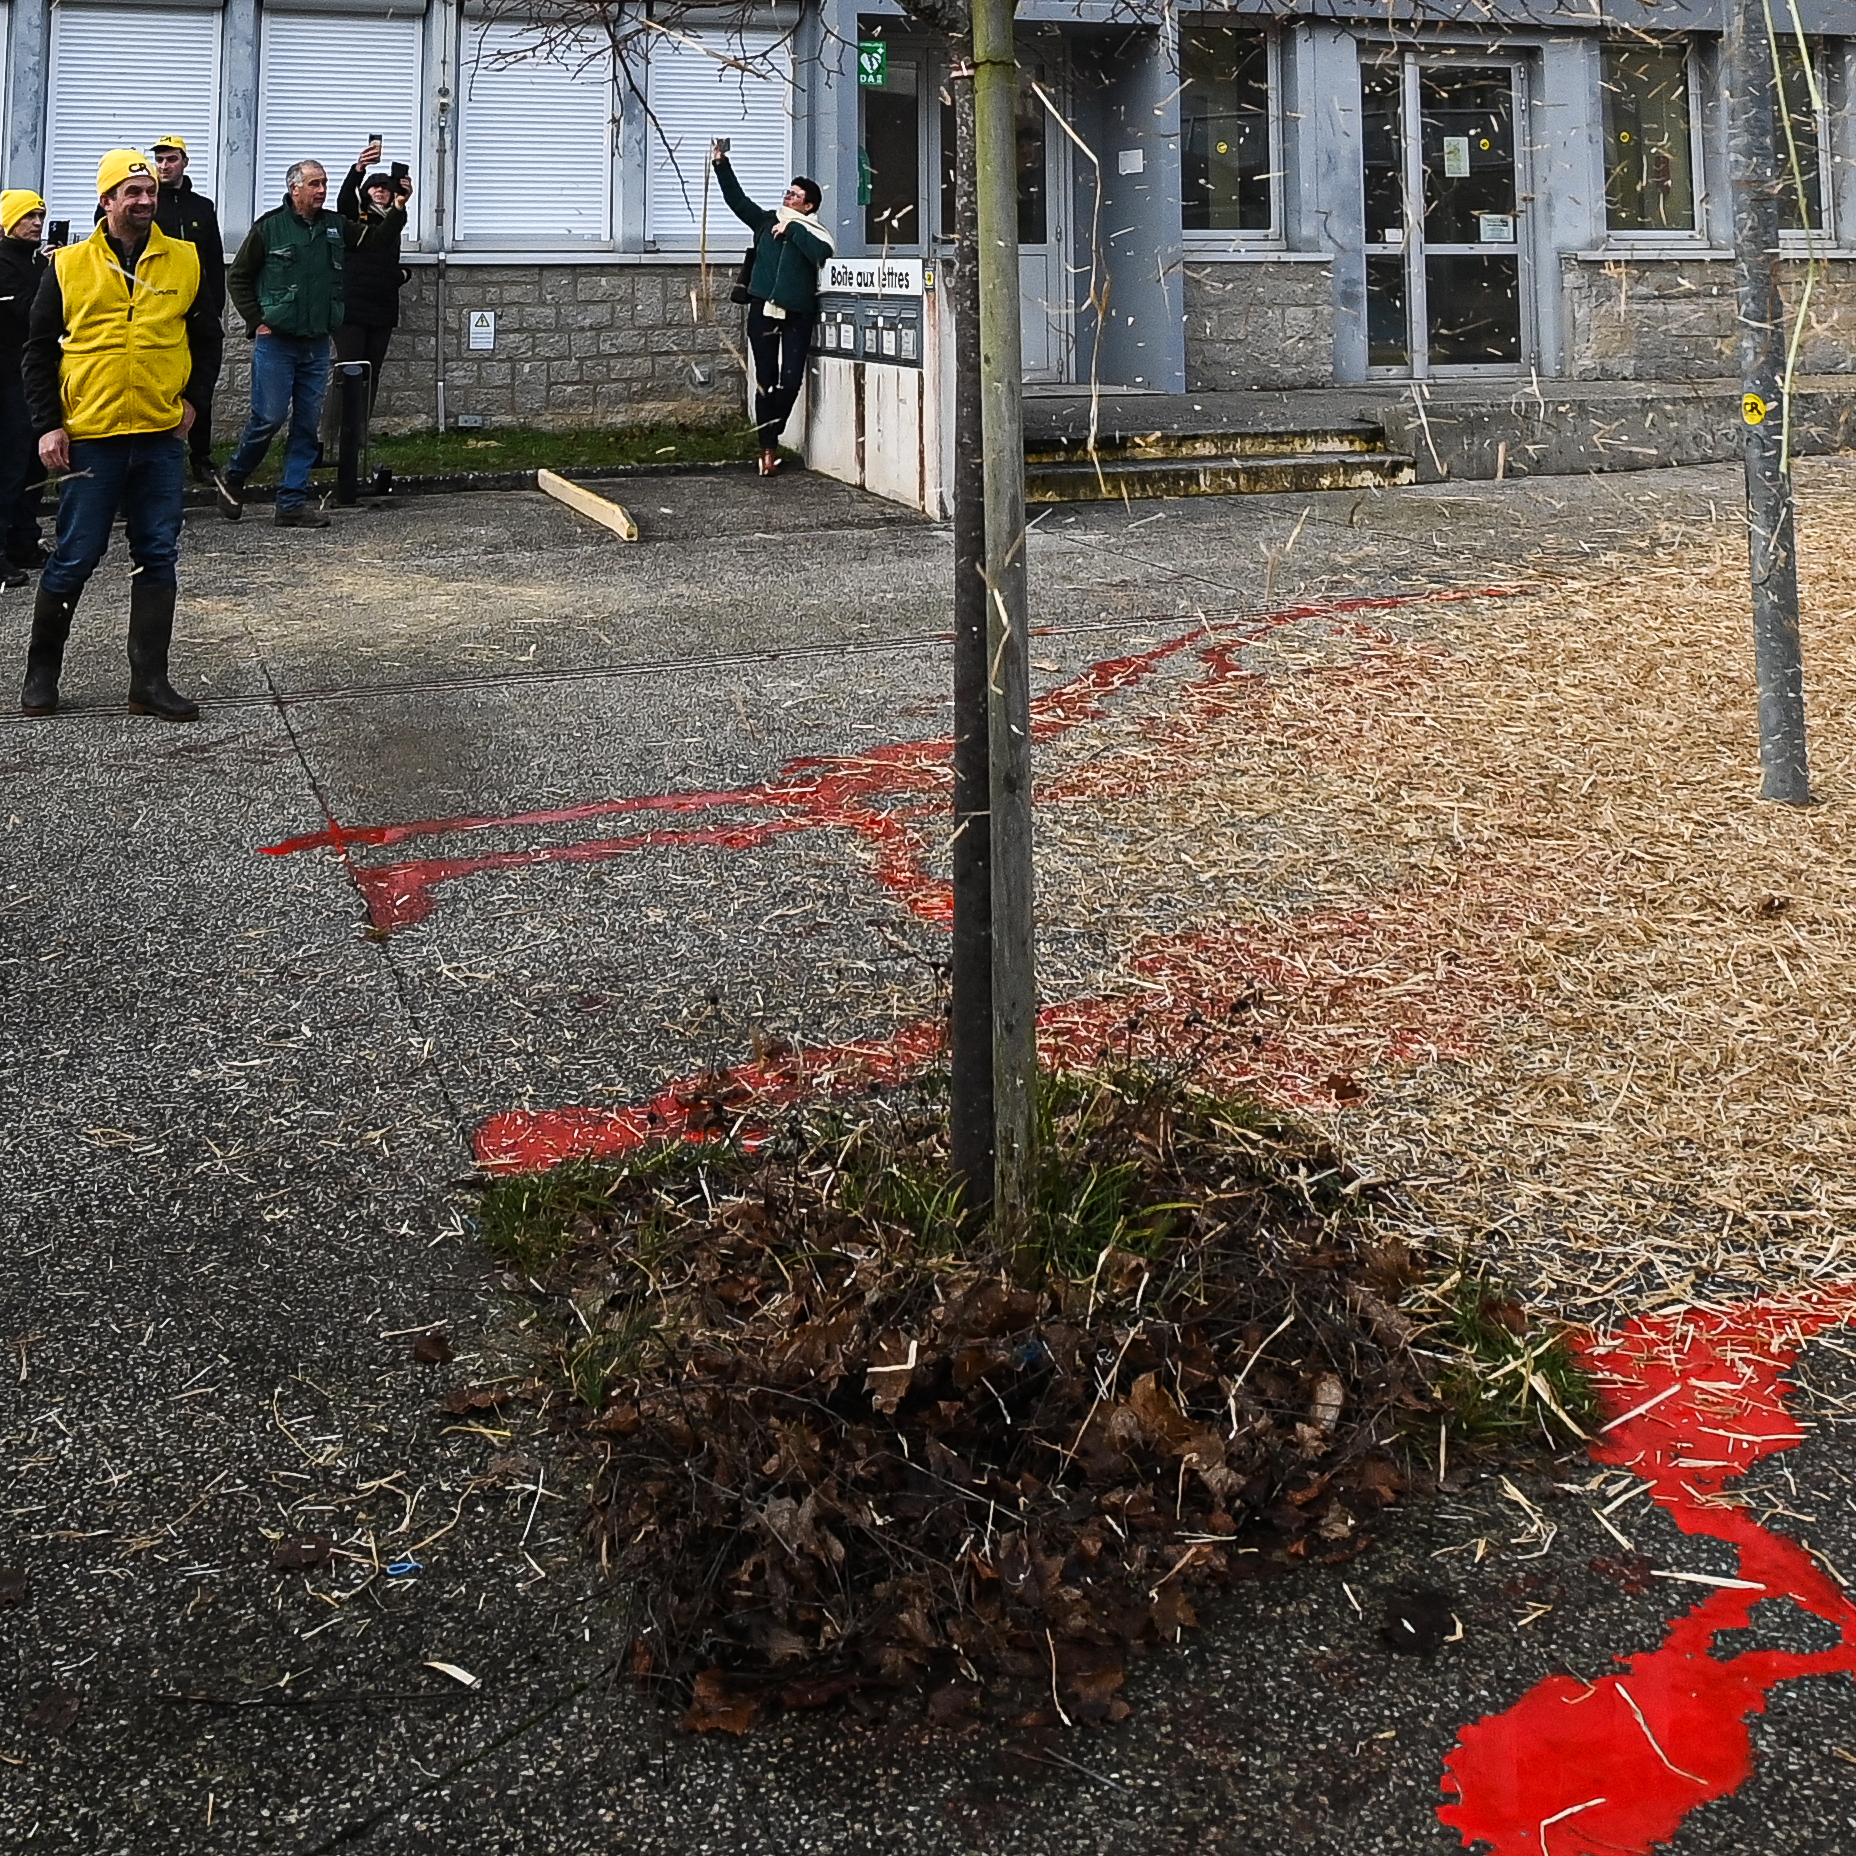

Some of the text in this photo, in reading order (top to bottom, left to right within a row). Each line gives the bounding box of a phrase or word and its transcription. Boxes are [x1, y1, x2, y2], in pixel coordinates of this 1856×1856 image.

[830, 264, 910, 290] Boîte aux lettres
